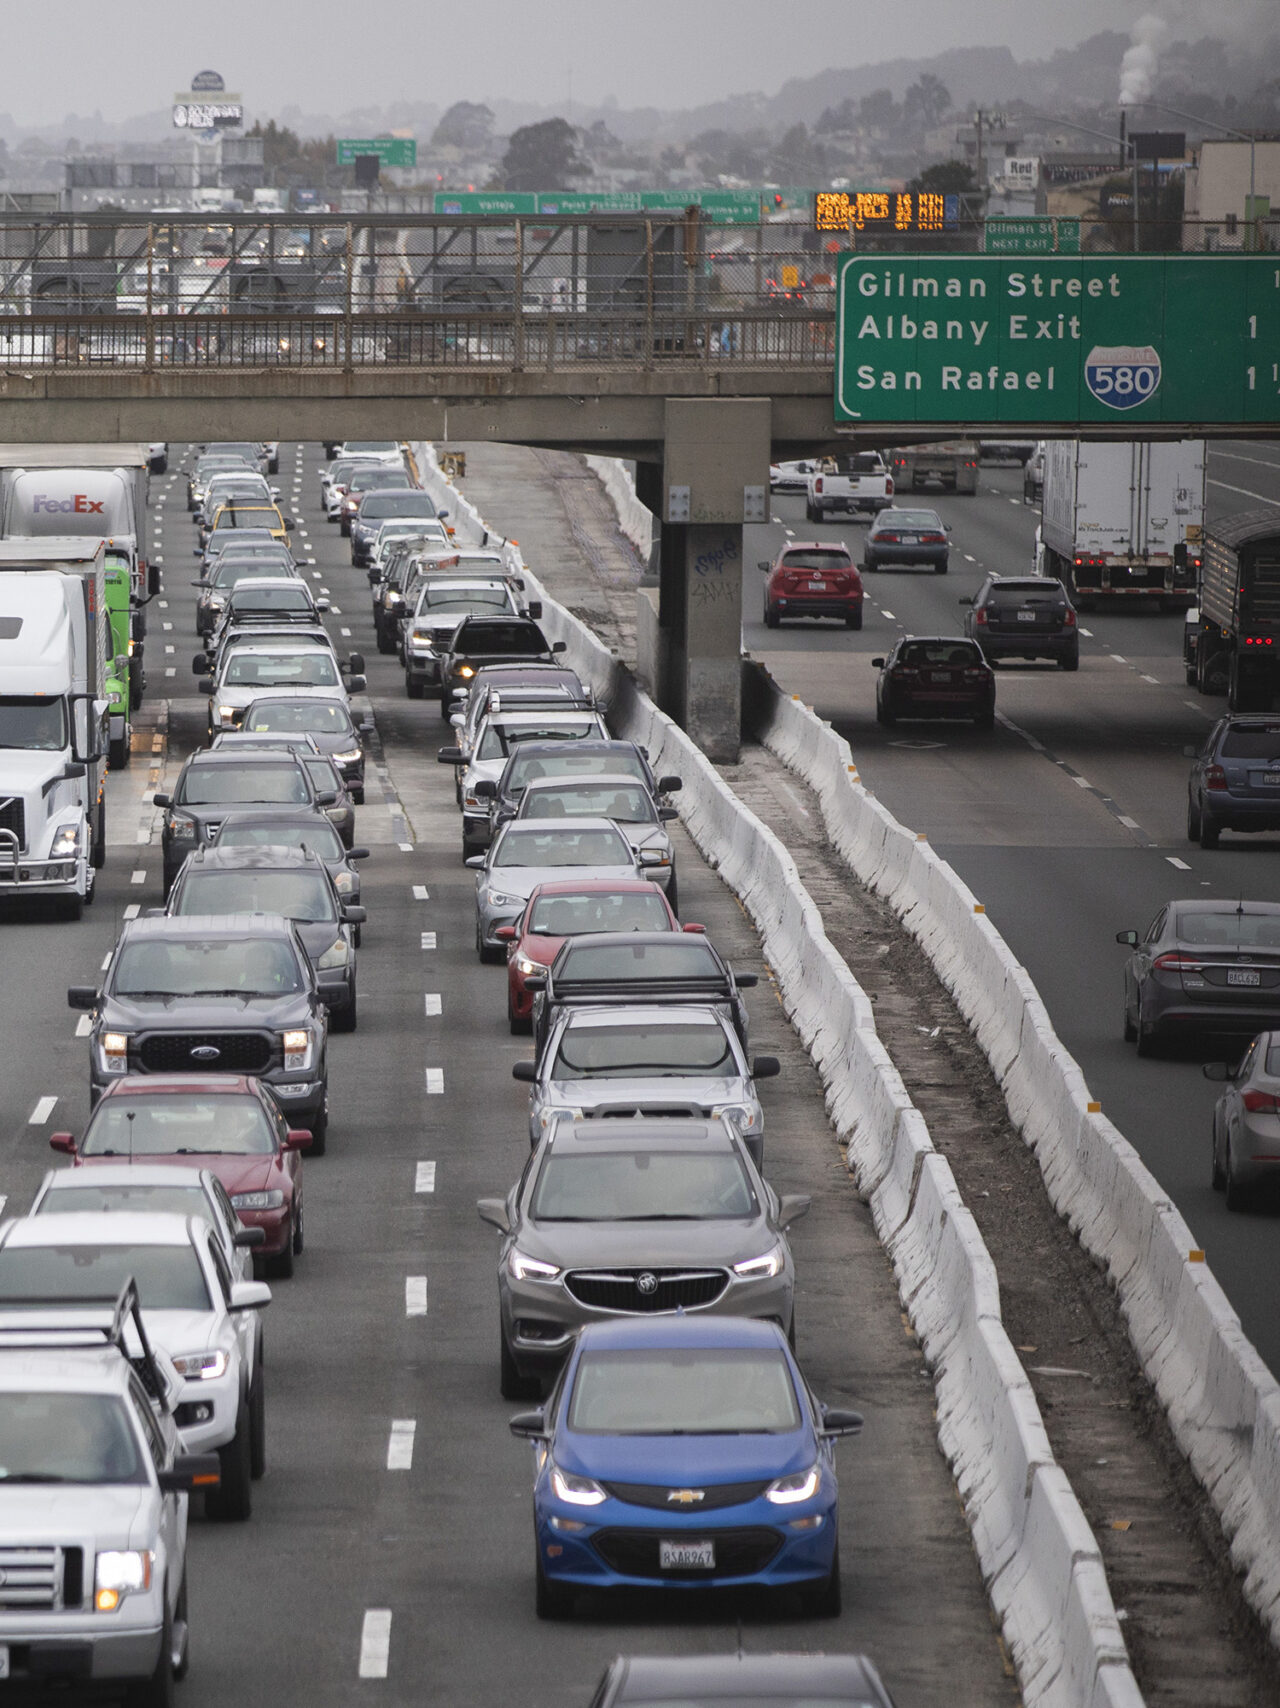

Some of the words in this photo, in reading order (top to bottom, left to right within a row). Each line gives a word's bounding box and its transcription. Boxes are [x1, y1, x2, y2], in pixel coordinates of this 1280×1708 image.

[1010, 161, 1032, 174] Red
[918, 193, 944, 205] MIN
[988, 223, 1035, 234] Gilman
[992, 240, 1019, 249] NEXT
[1025, 240, 1048, 249] EXIT
[858, 271, 987, 298] Gilman
[1007, 273, 1121, 298] Street
[857, 314, 989, 346] Albany
[1009, 314, 1082, 340] Exit
[1248, 315, 1257, 339] 1
[856, 366, 922, 390] San
[941, 365, 1055, 390] Rafael
[1094, 367, 1155, 395] 580
[1247, 366, 1256, 390] 1
[33, 494, 105, 514] FedEx
[663, 1550, 711, 1564] 8SAR967
